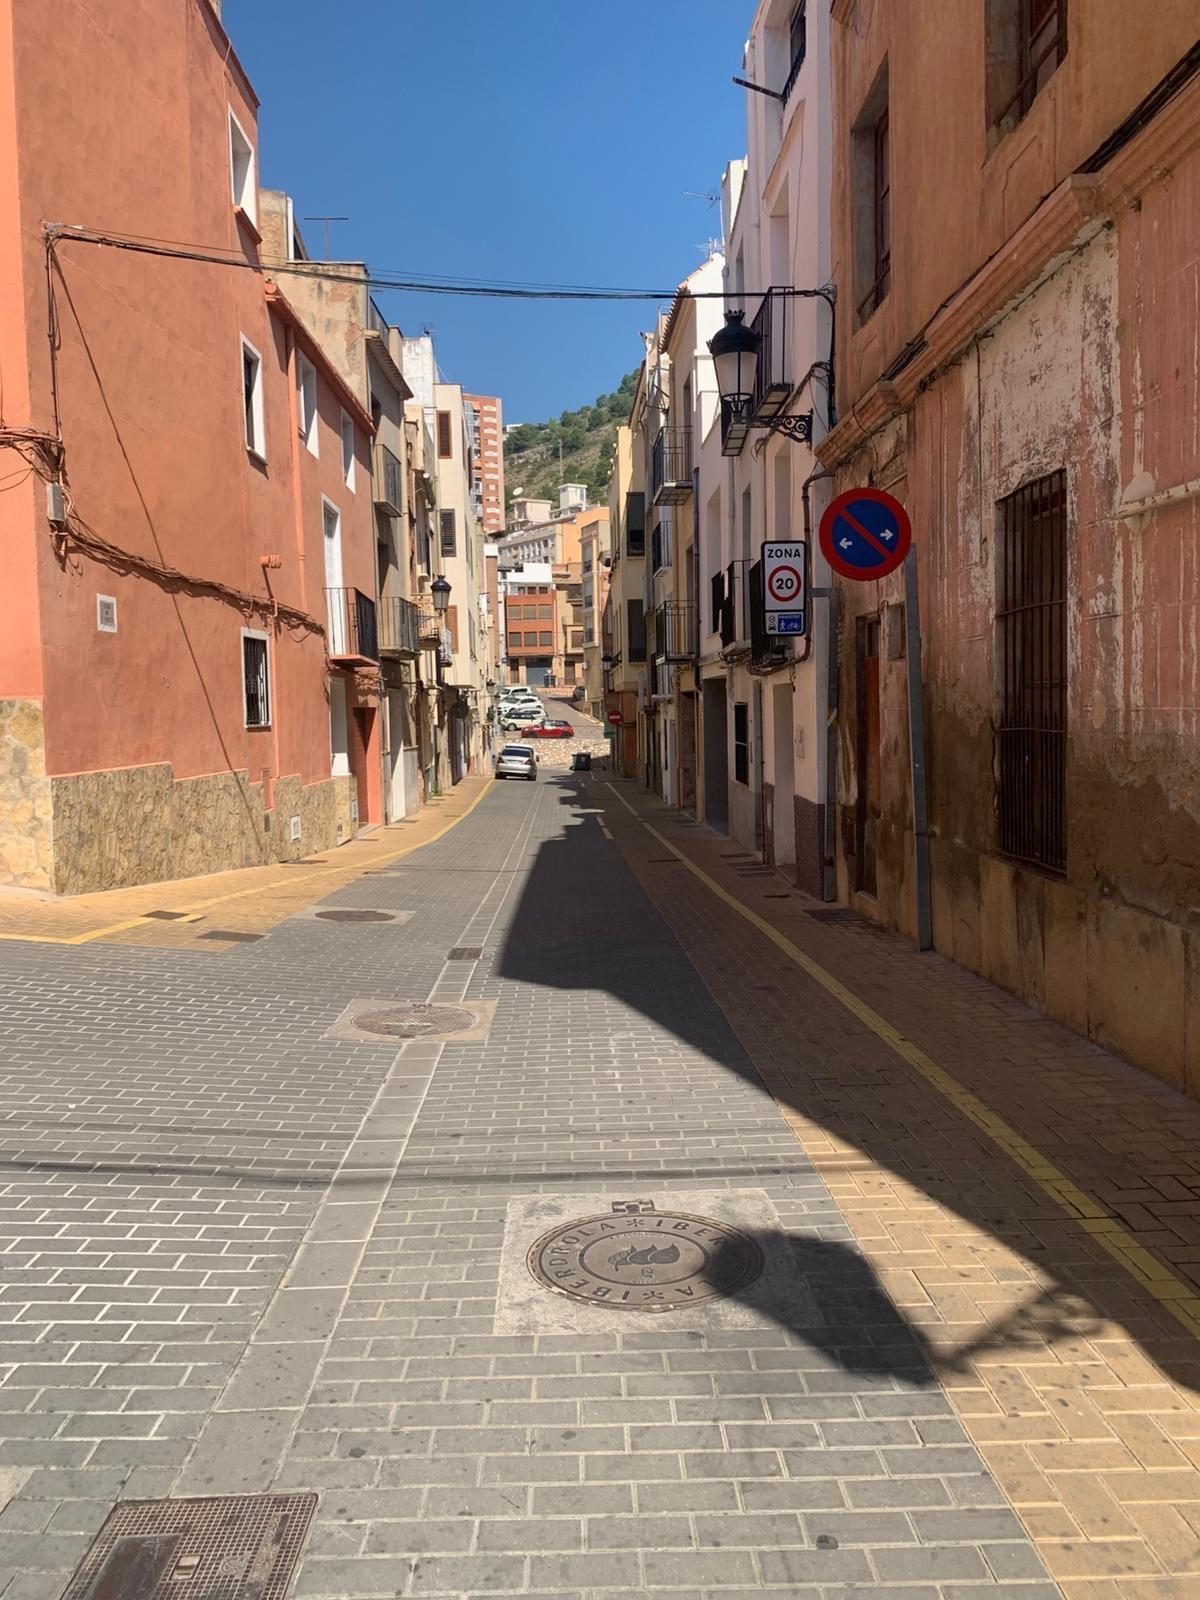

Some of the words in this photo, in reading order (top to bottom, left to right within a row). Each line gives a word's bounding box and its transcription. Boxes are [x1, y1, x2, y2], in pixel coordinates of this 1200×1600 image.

[767, 548, 801, 559] ZONA
[775, 577, 794, 590] 20
[549, 1221, 632, 1301] IBERDROLA
